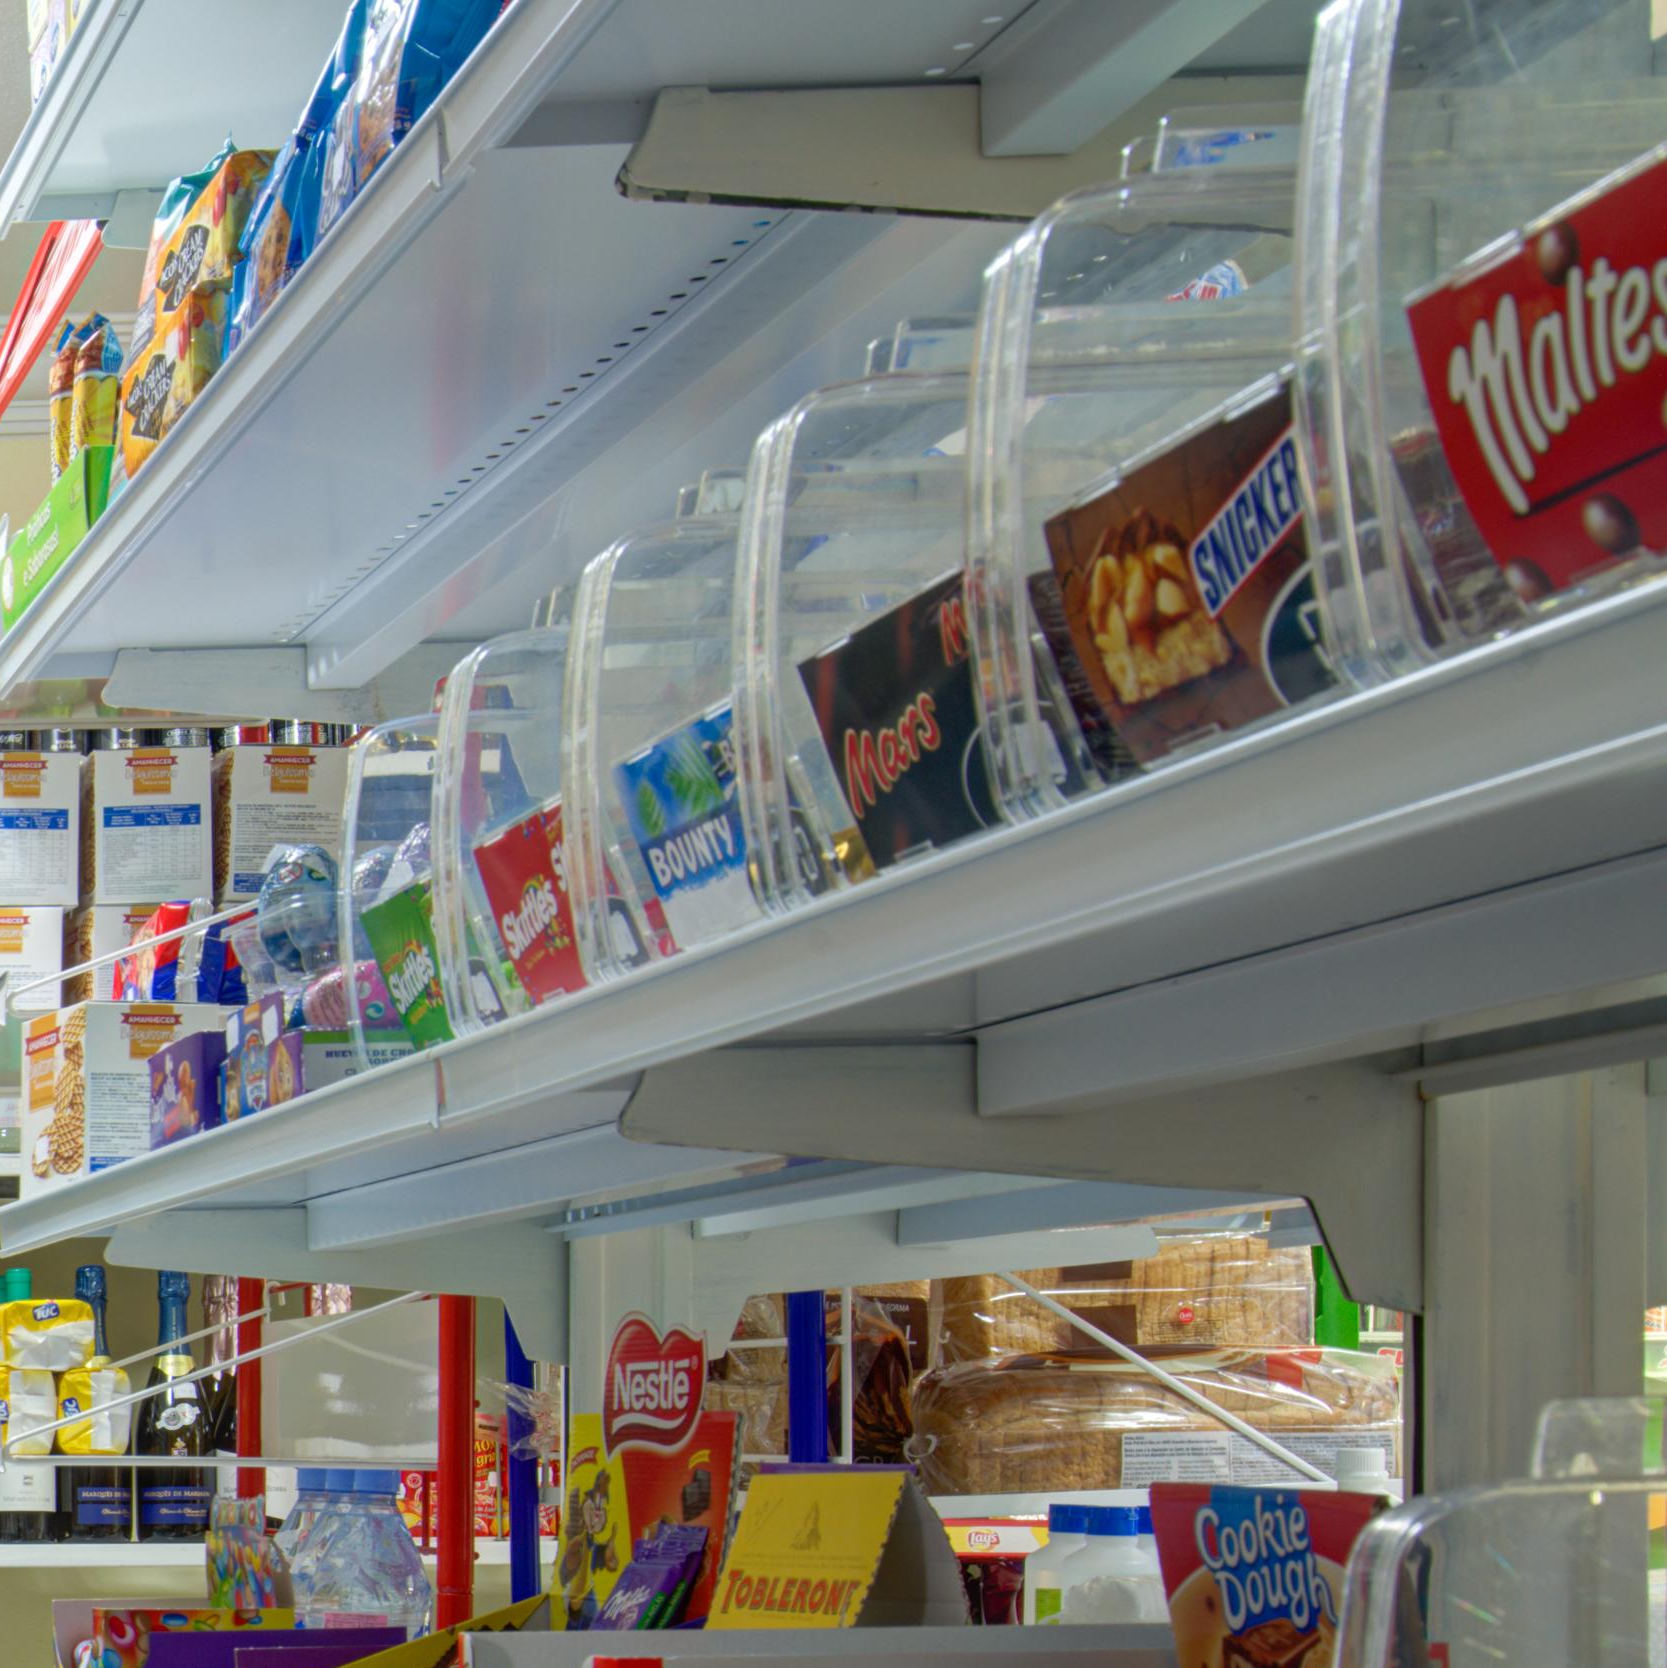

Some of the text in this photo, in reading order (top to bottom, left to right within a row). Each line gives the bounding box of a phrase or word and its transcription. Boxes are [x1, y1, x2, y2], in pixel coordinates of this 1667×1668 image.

[842, 692, 941, 819] Mars
[648, 815, 734, 888] BOUNTY
[502, 879, 558, 958] Skittles
[387, 944, 434, 1016] Skittles
[128, 1014, 177, 1025] AMANHECER
[34, 1304, 60, 1320] TUC
[613, 1360, 690, 1412] Nestlé
[1194, 1496, 1310, 1572] Cookie
[603, 1580, 652, 1616] Milka
[722, 1569, 861, 1616] TOBLERONE
[1213, 1552, 1340, 1635] Dough
